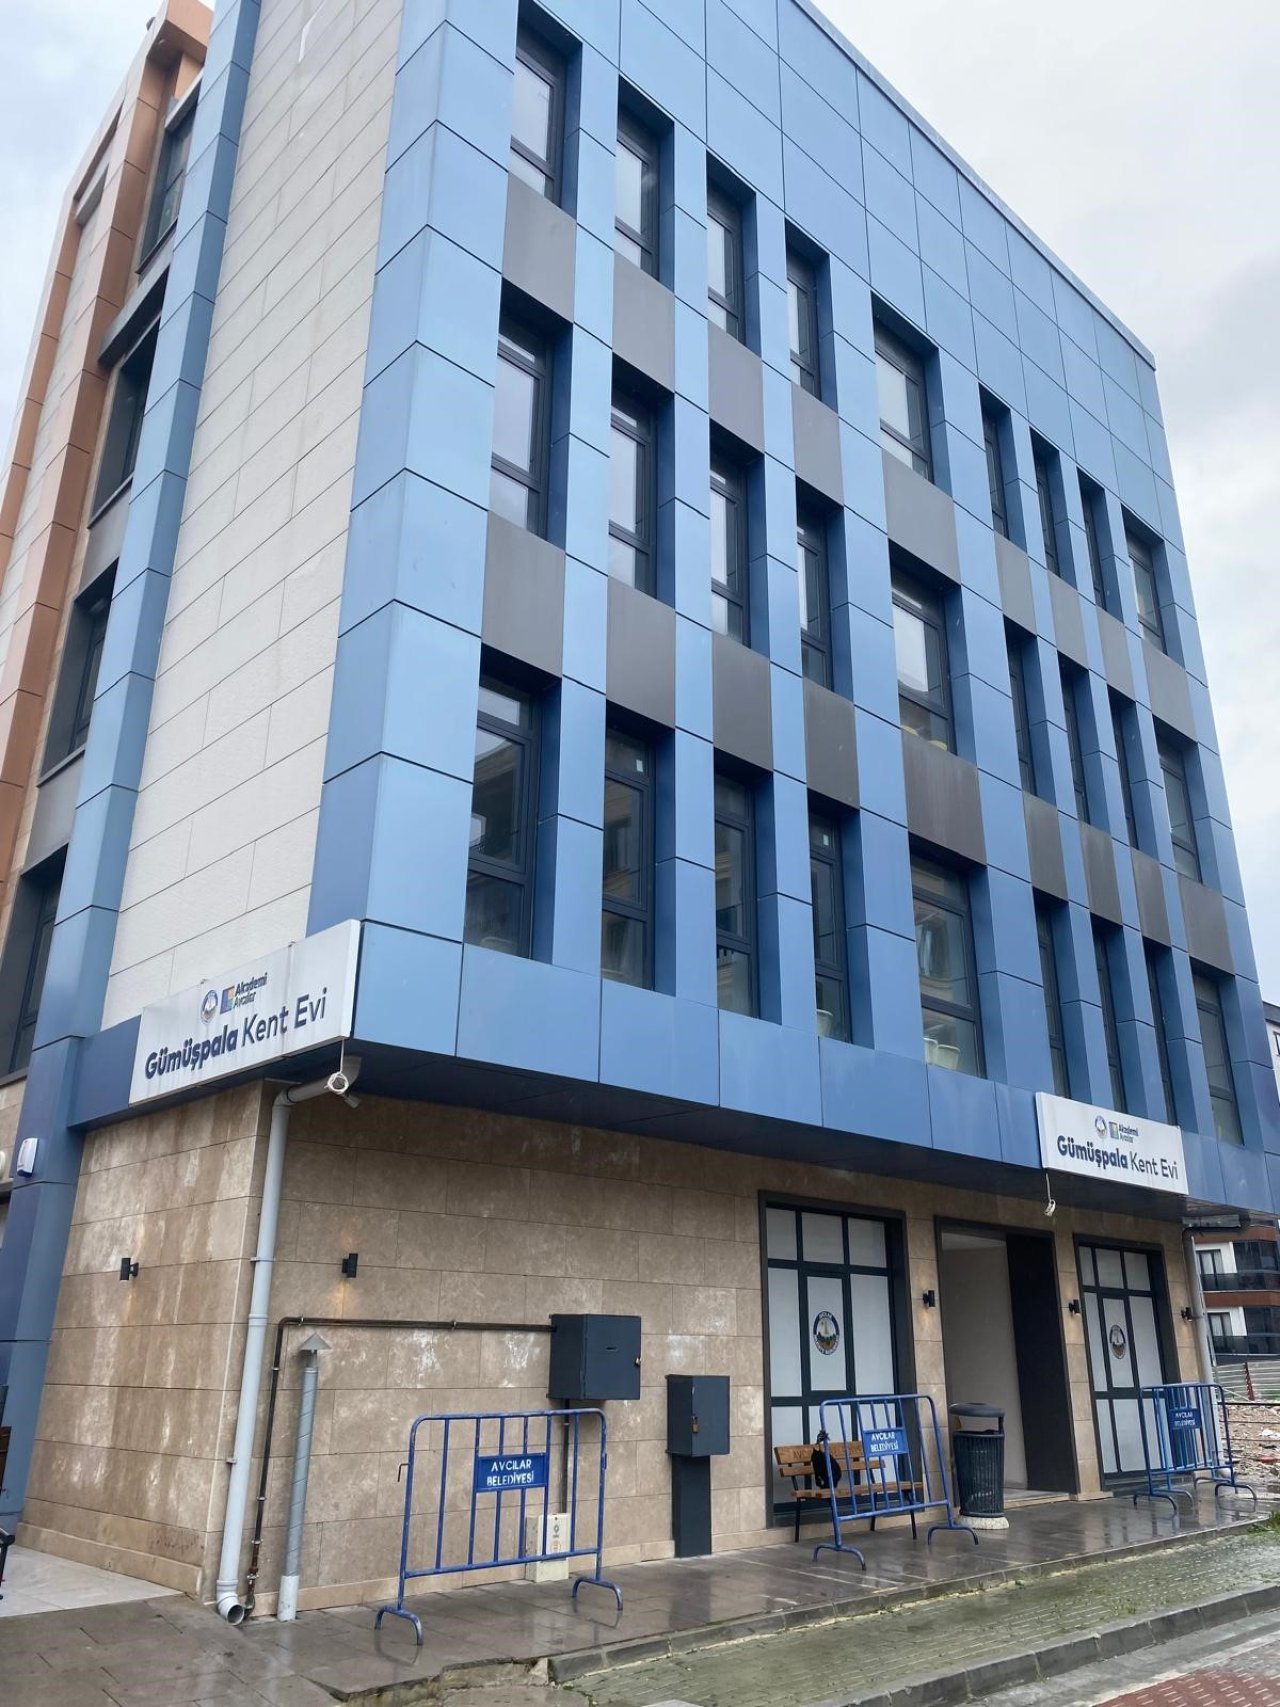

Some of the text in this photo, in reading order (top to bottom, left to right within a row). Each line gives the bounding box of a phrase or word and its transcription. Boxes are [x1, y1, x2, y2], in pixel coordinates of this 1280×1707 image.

[145, 1024, 238, 1079] Gümüşpala
[241, 1006, 289, 1047] Kent
[294, 987, 327, 1029] Evi
[1057, 1135, 1179, 1180] Gümüşpala Kent Evi
[871, 1431, 895, 1441] AVCILAR
[491, 1459, 532, 1472] AVCILAR
[487, 1470, 534, 1486] BELEDİYESİ
